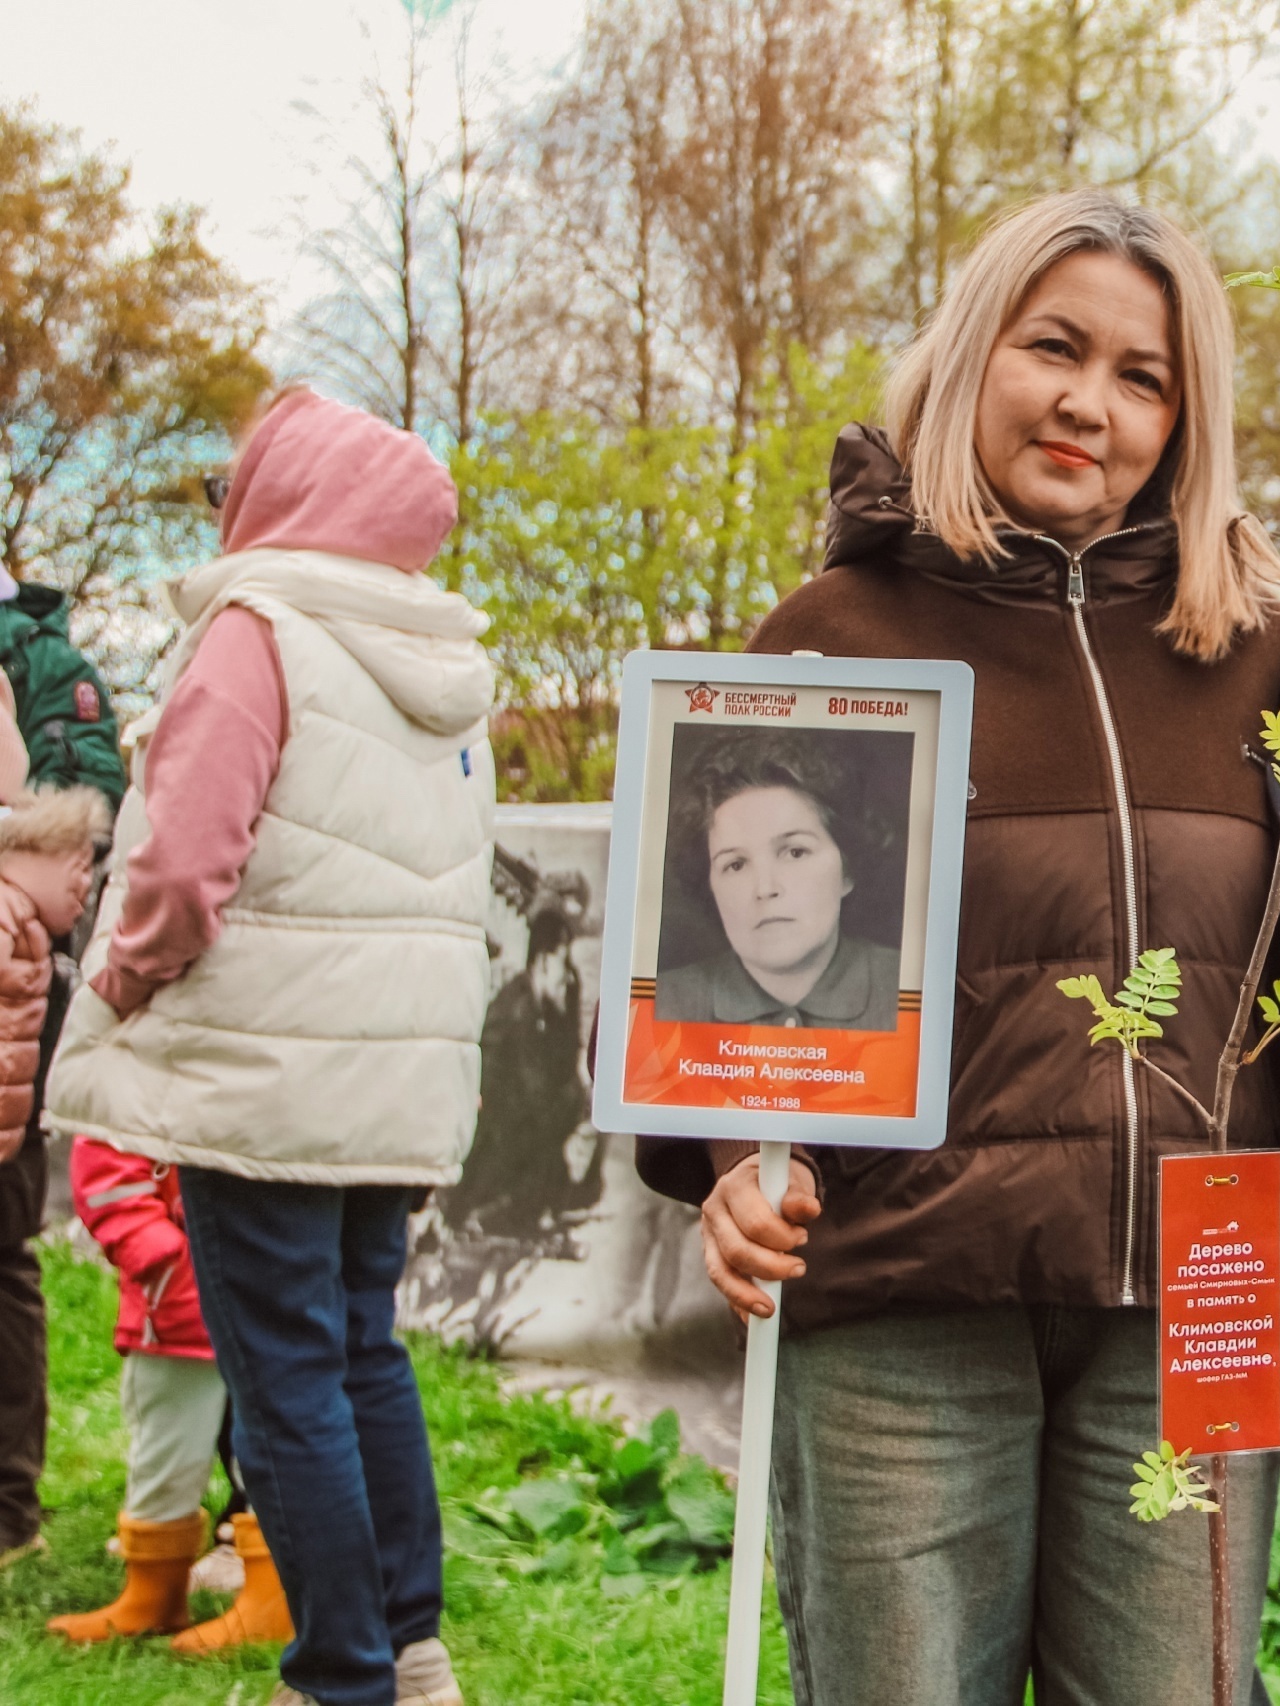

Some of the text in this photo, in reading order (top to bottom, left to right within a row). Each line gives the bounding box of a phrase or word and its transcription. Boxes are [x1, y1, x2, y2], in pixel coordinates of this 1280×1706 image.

[725, 692, 797, 706] БЕССМЕРТНЫЙ
[828, 697, 909, 717] 80 ПОБЕДА!
[725, 704, 792, 718] ПОЛК РОССИИ
[718, 1040, 828, 1060] Климовская
[679, 1058, 866, 1084] Клавдия Алексеевна
[740, 1095, 801, 1110] 1924-1988
[1188, 1243, 1253, 1261] Дерево
[1177, 1260, 1265, 1278] посажено
[1167, 1281, 1199, 1292] семьей
[1186, 1293, 1257, 1309] в память о
[1169, 1315, 1274, 1338] Климовской
[1184, 1337, 1258, 1355] Клавдии
[1169, 1353, 1277, 1373] Алексеевне,
